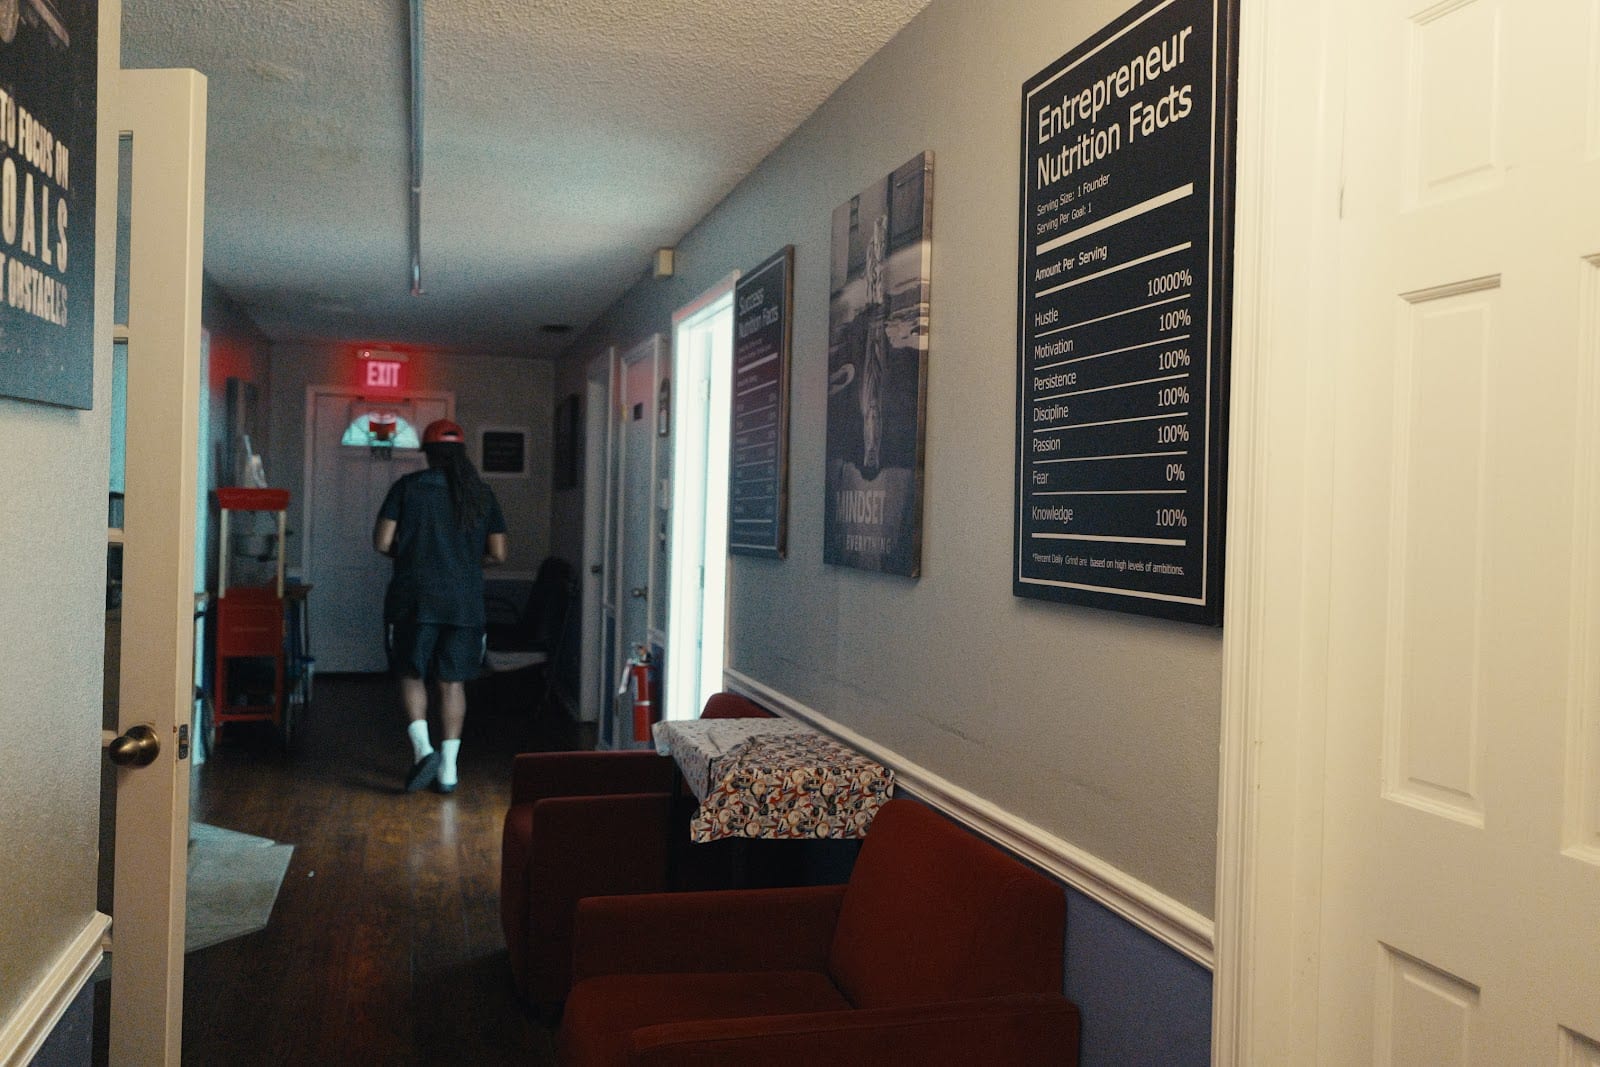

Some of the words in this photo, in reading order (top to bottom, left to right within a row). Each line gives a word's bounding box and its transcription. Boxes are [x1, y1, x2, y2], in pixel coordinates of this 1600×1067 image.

[1038, 25, 1192, 145] Entrepreneur
[19, 105, 53, 178] FOCUS
[55, 140, 69, 191] ON
[1037, 121, 1120, 190] Nutrition
[1129, 84, 1192, 144] Facts
[1037, 198, 1059, 216] Serving
[1060, 191, 1075, 206] Size:
[1078, 185, 1082, 198] 1
[1083, 174, 1110, 195] Founder
[2, 157, 68, 273] OALS
[1036, 217, 1059, 235] Serving
[1060, 213, 1070, 225] Per
[1072, 205, 1086, 220] Goal:
[1088, 202, 1092, 213] 1
[1035, 261, 1061, 281] Amount
[1063, 257, 1075, 271] Per
[1079, 246, 1107, 266] Serving
[8, 257, 68, 328] OBSTACLES
[1034, 307, 1059, 327] Hustle
[1147, 269, 1192, 297] 10000%
[1034, 339, 1073, 360] Motivation
[1159, 309, 1191, 332] 100%
[367, 361, 400, 387] EXIT
[1034, 372, 1076, 391] Persistence
[1158, 349, 1190, 371] 100%
[1033, 404, 1069, 422] Discipline
[1157, 386, 1190, 407] 100%
[1033, 437, 1060, 452] Passion
[1157, 424, 1189, 444] 100%
[1032, 470, 1049, 485] Fear
[1166, 463, 1185, 482] 0%
[836, 490, 886, 525] MINDSET
[1032, 505, 1073, 524] Knowledge
[1155, 508, 1188, 528] 100%
[1052, 553, 1063, 566] Daily
[1079, 558, 1088, 566] are
[1090, 557, 1106, 568] based
[1106, 560, 1114, 569] on
[1114, 559, 1127, 572] high
[1128, 560, 1144, 572] levels
[1145, 561, 1152, 572] of
[1152, 563, 1185, 576] ambitions.
